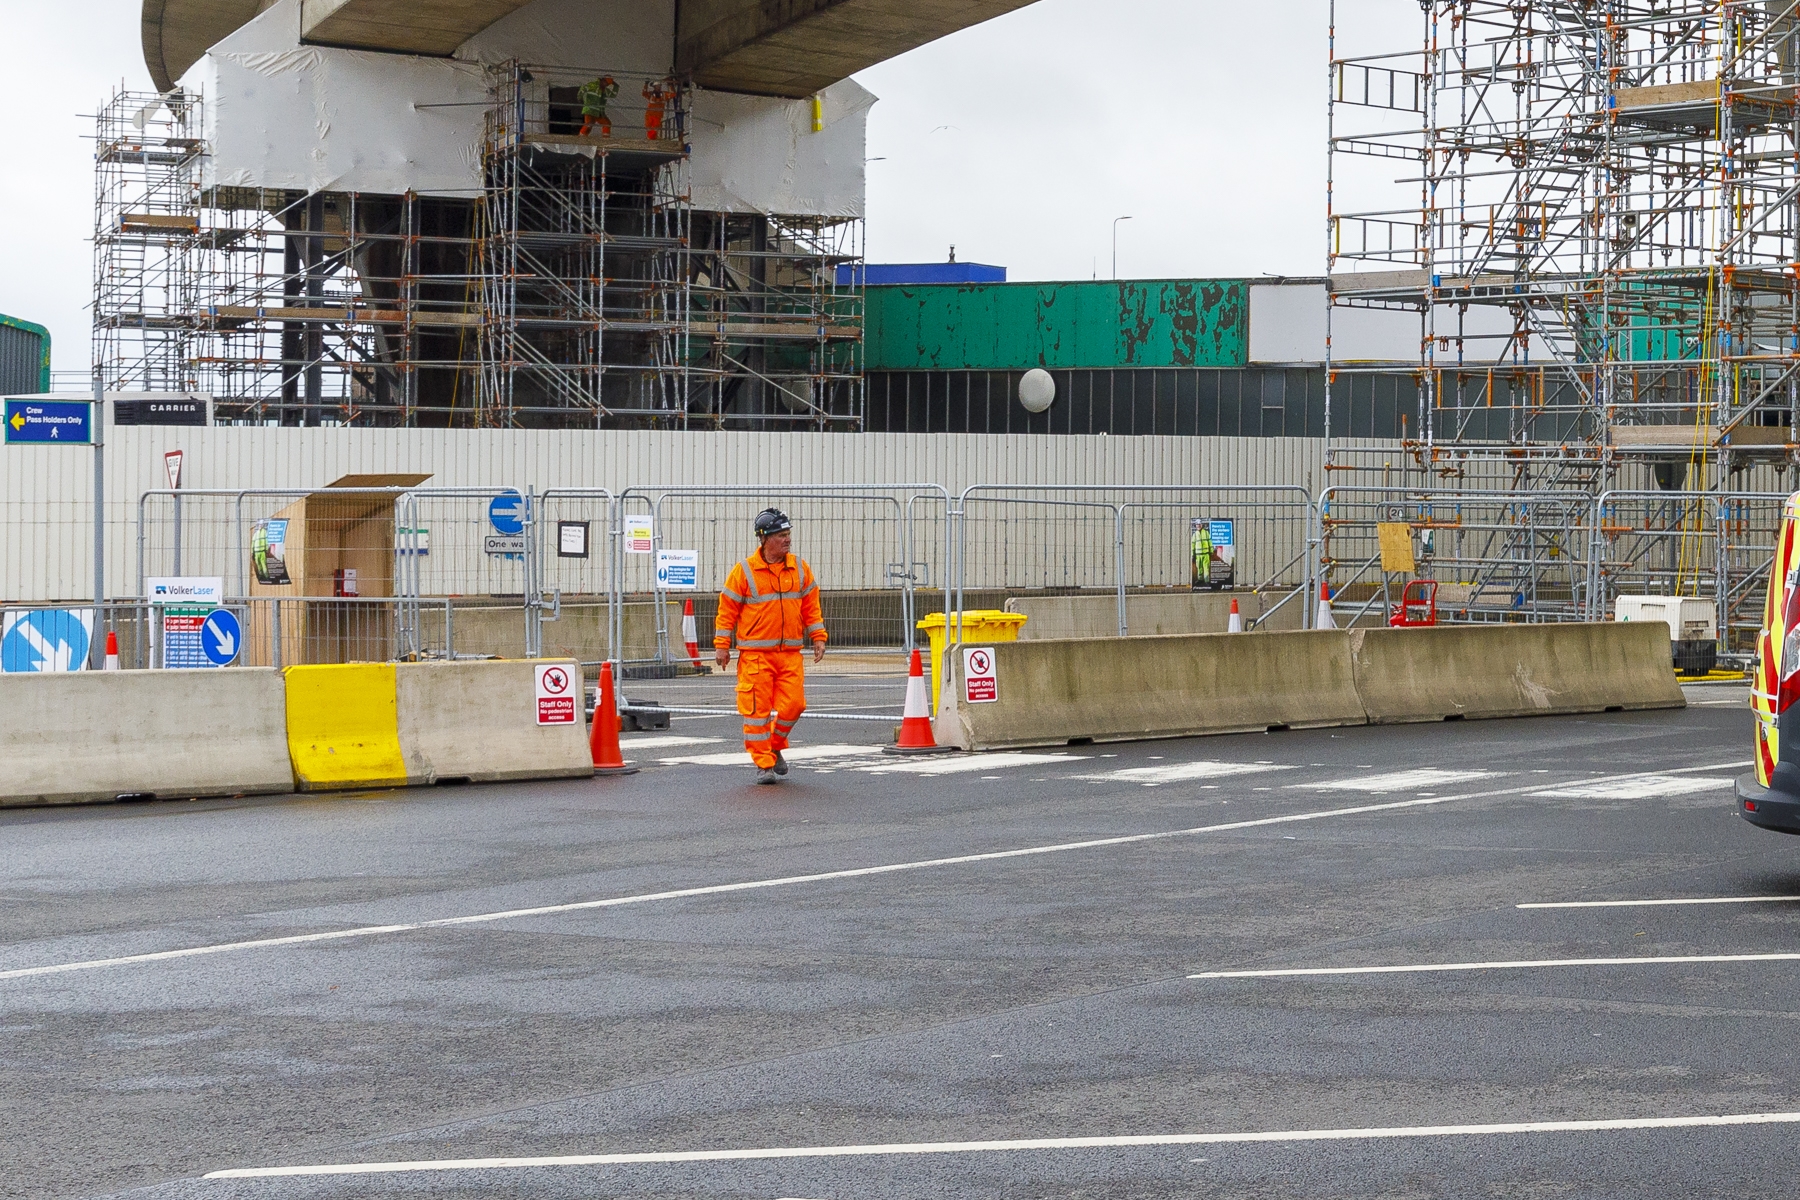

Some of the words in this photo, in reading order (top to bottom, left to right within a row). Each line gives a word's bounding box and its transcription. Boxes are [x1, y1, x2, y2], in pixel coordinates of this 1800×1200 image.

[150, 404, 196, 412] CARRIER
[26, 416, 42, 424] Pass
[43, 416, 67, 424] Holders
[68, 416, 82, 425] Only
[488, 540, 506, 548] One
[168, 586, 214, 595] VolkerLaser
